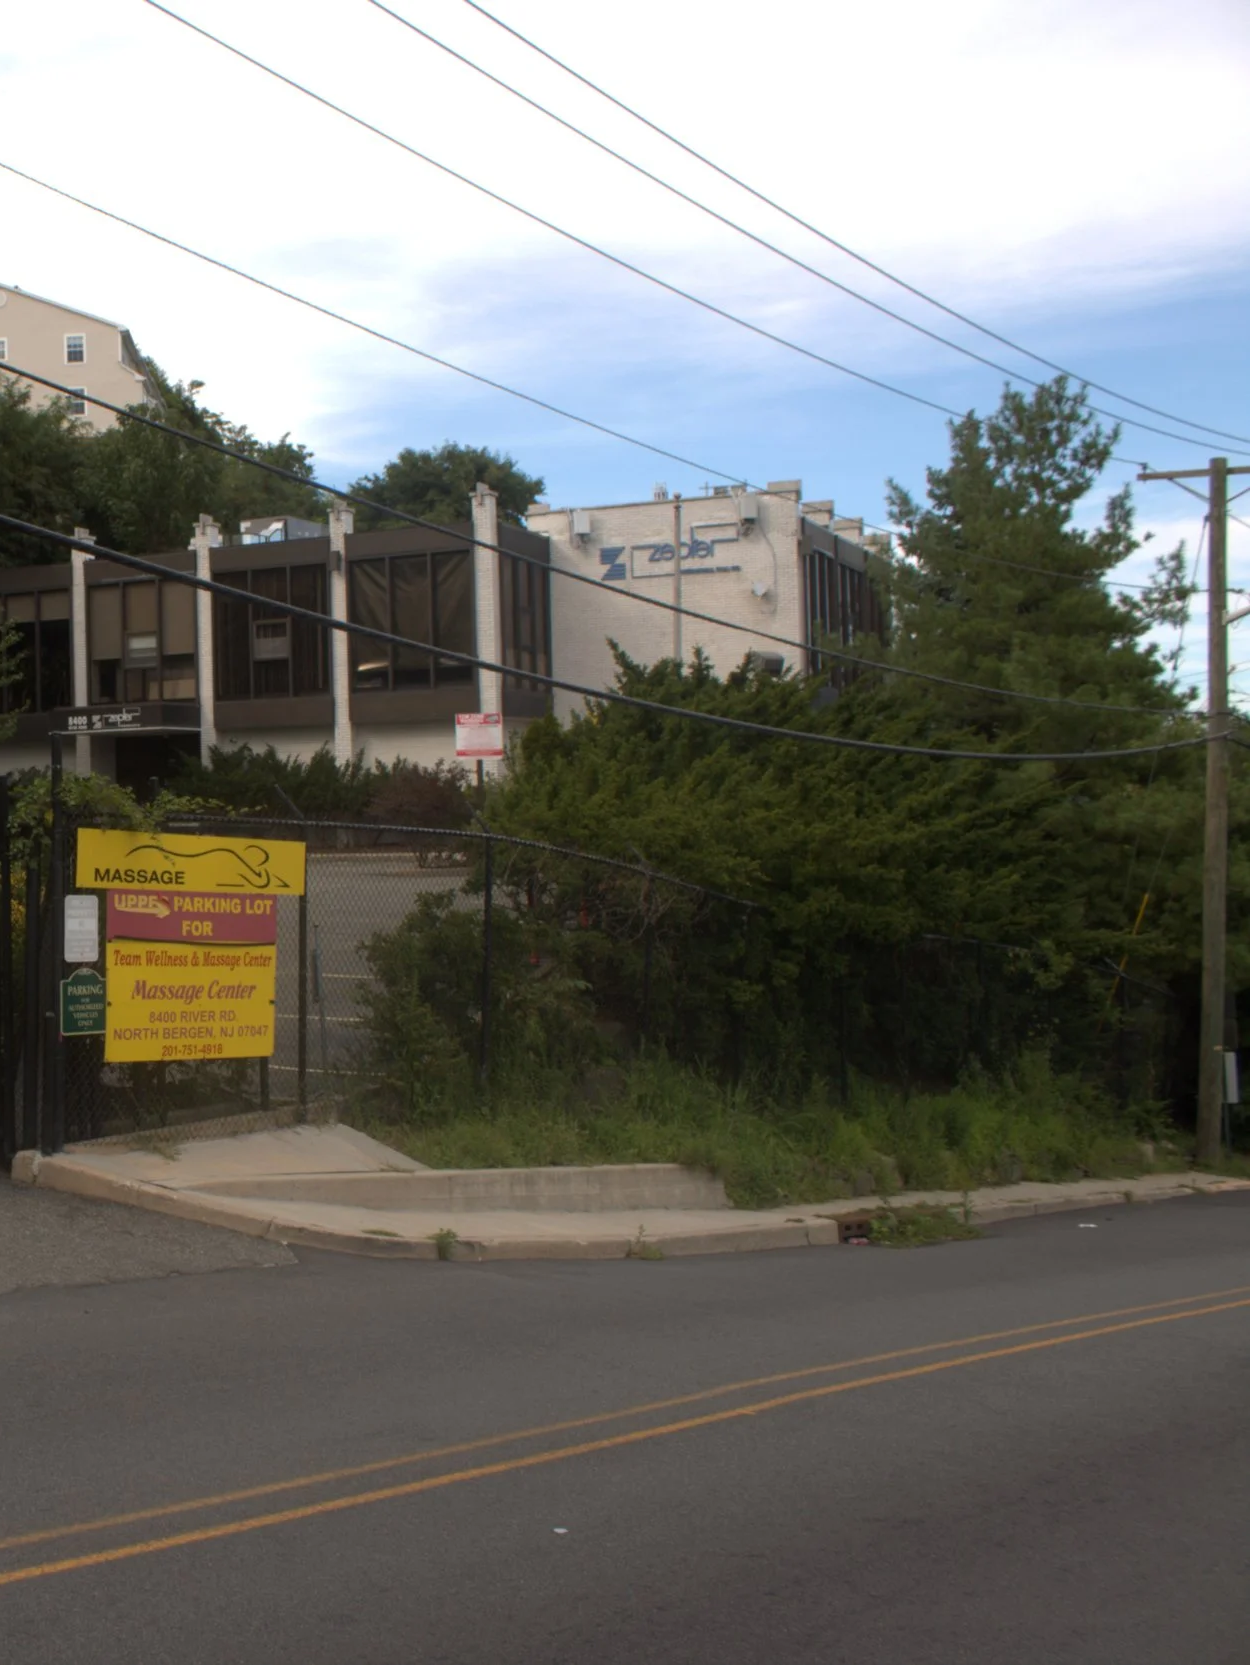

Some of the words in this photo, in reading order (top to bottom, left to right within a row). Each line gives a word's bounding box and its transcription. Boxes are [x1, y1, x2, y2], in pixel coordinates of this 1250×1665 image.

[94, 867, 185, 885] MASSAGE
[173, 895, 242, 914] PARKING
[245, 899, 273, 915] LOT
[181, 920, 213, 936] FOR
[114, 950, 142, 966] Team
[146, 950, 188, 967] Wellness
[191, 951, 199, 967] &
[202, 951, 241, 971] Massage
[244, 952, 271, 967] Center
[67, 984, 103, 996] PARKING
[132, 980, 204, 1005] Massage
[207, 979, 256, 1000] Center
[149, 1011, 177, 1023] 8400
[180, 1010, 215, 1022] RIVER
[113, 1028, 159, 1040] NORTH
[220, 1026, 234, 1038] NJ
